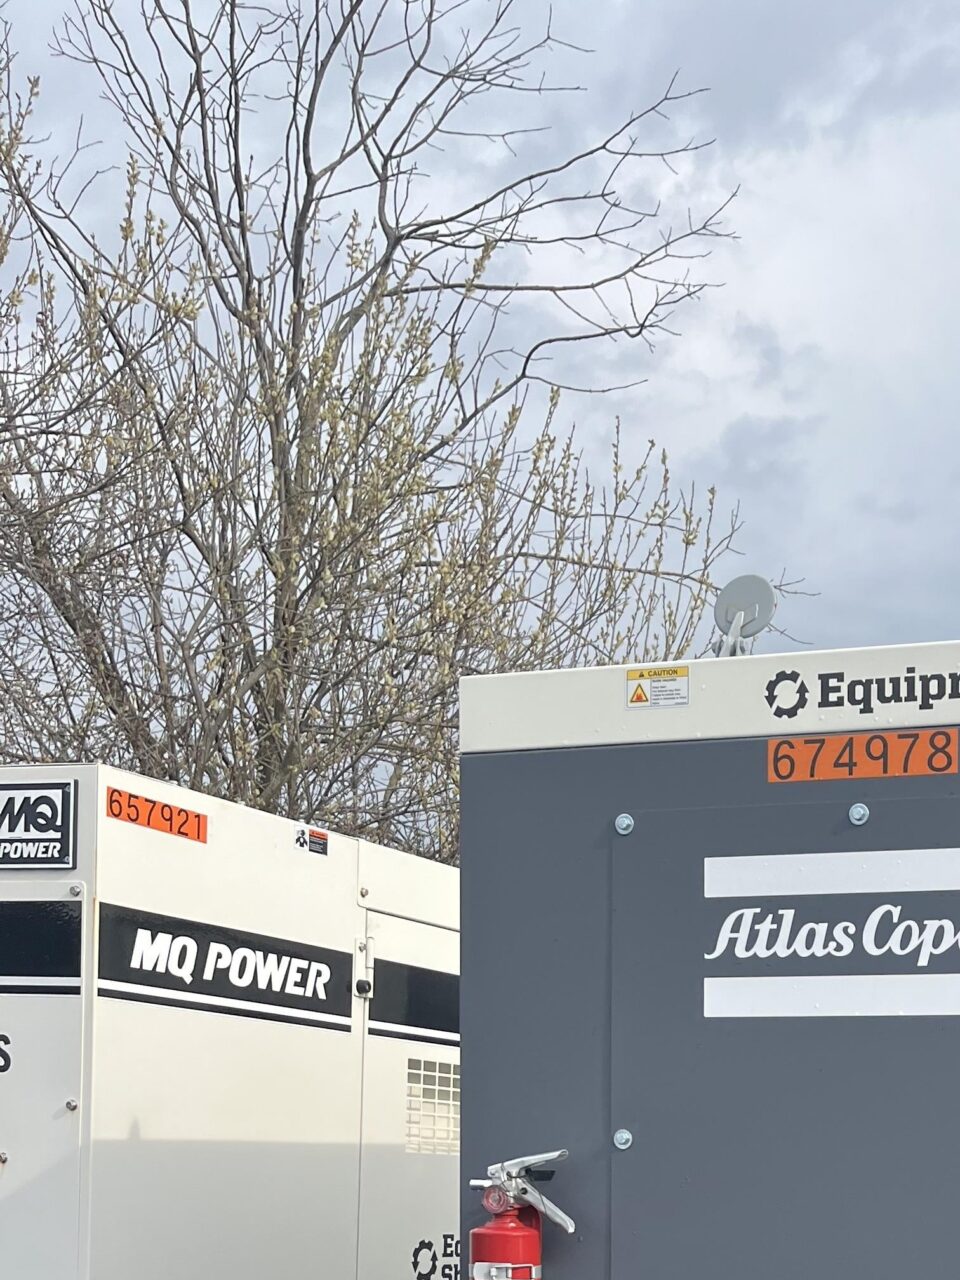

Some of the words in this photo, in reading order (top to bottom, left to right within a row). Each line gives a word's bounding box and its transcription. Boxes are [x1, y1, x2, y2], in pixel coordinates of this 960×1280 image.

[647, 669, 678, 677] CAUTION
[772, 730, 953, 781] 674978
[0, 795, 62, 833] MQ
[109, 789, 202, 840] 657921
[0, 842, 61, 859] POWER
[704, 907, 857, 960] Atlas
[130, 928, 198, 985] MQ
[203, 941, 331, 1001] POWER
